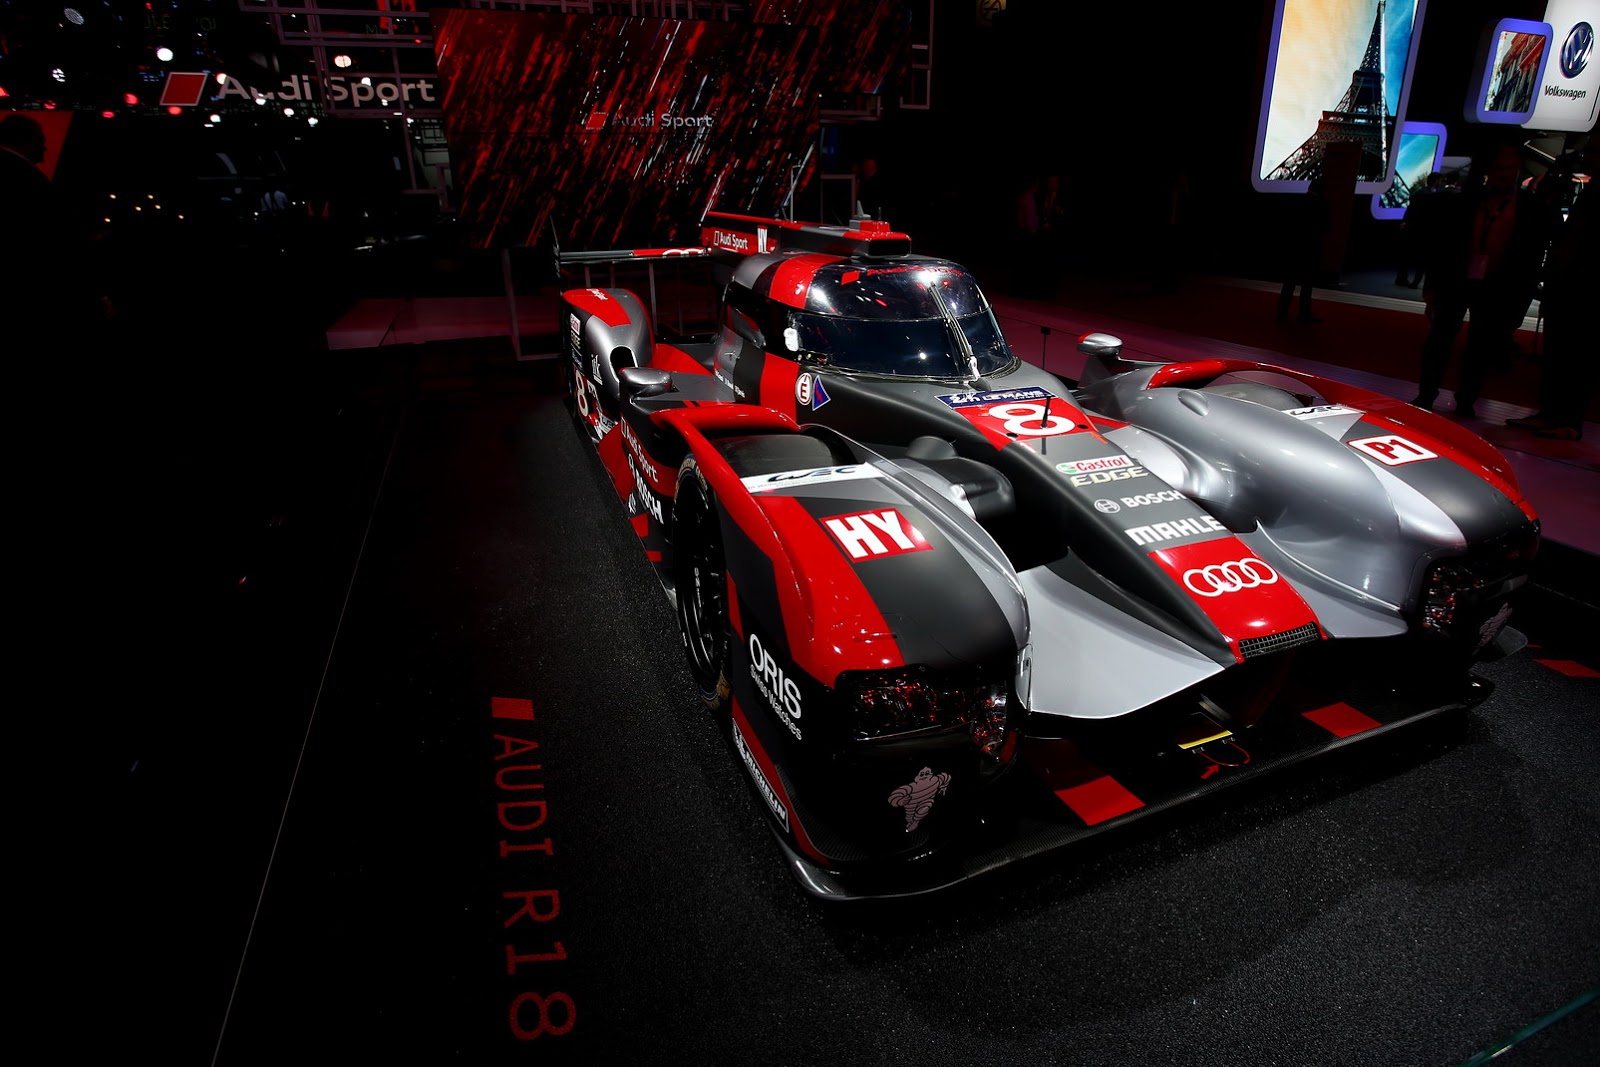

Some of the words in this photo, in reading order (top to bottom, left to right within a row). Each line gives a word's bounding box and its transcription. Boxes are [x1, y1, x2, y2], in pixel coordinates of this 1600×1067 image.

[324, 76, 435, 107] Sport
[1544, 85, 1587, 100] Volkswagen
[611, 112, 655, 127] Audi
[660, 112, 713, 129] Sport
[720, 231, 732, 246] Audi
[732, 233, 748, 250] Sport
[575, 369, 589, 417] 8
[988, 403, 1076, 436] 8
[1075, 456, 1129, 472] Castrol
[1364, 439, 1424, 460] P1
[1069, 466, 1150, 487] EDGE
[1120, 489, 1187, 508] BOSCH
[824, 510, 916, 559] HY
[1124, 515, 1228, 546] MAHLE
[750, 633, 802, 719] ORIS
[768, 690, 802, 740] Watches
[492, 733, 555, 860] AUDI
[502, 888, 577, 1042] R18
